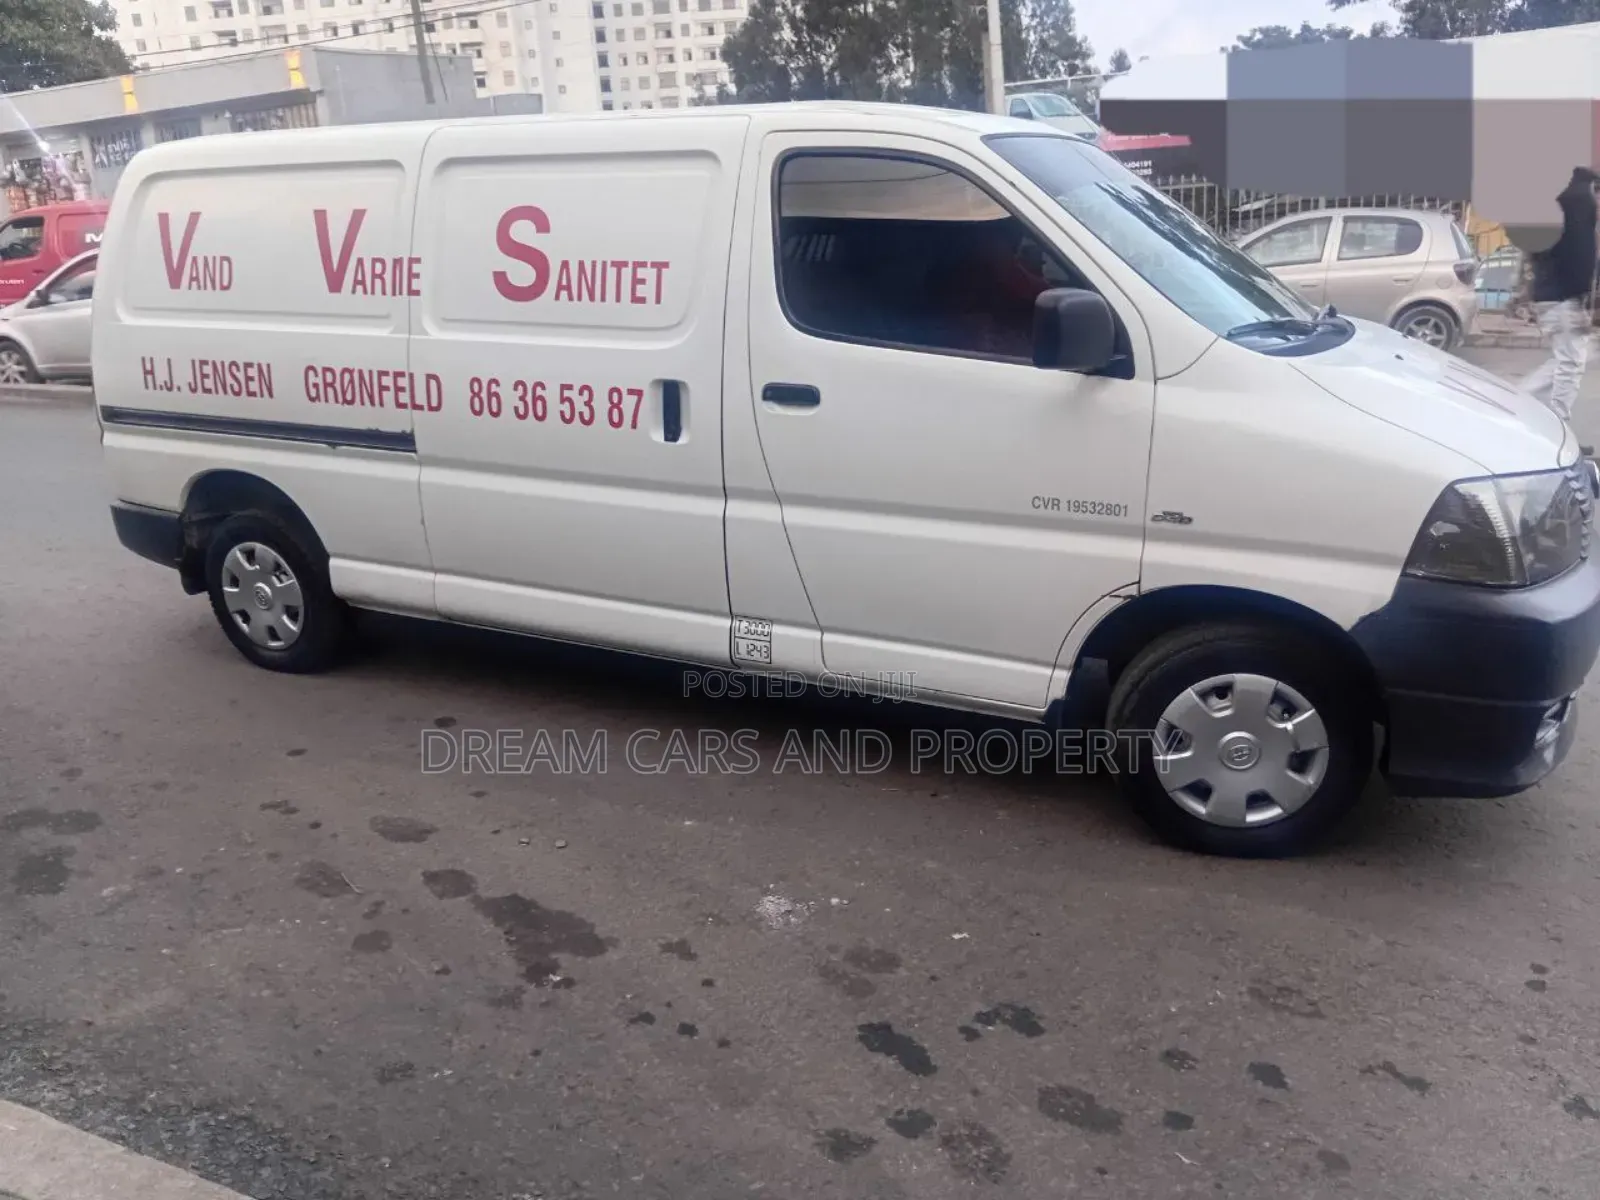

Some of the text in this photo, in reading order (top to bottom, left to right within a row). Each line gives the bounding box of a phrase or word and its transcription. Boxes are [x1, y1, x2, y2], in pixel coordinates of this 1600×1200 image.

[157, 211, 233, 291] VAND
[492, 205, 669, 305] SANITET
[141, 356, 644, 430] H.J. JENSEN GRØNFELD 86 36 53 87
[1031, 495, 1129, 518] CVR 19532801
